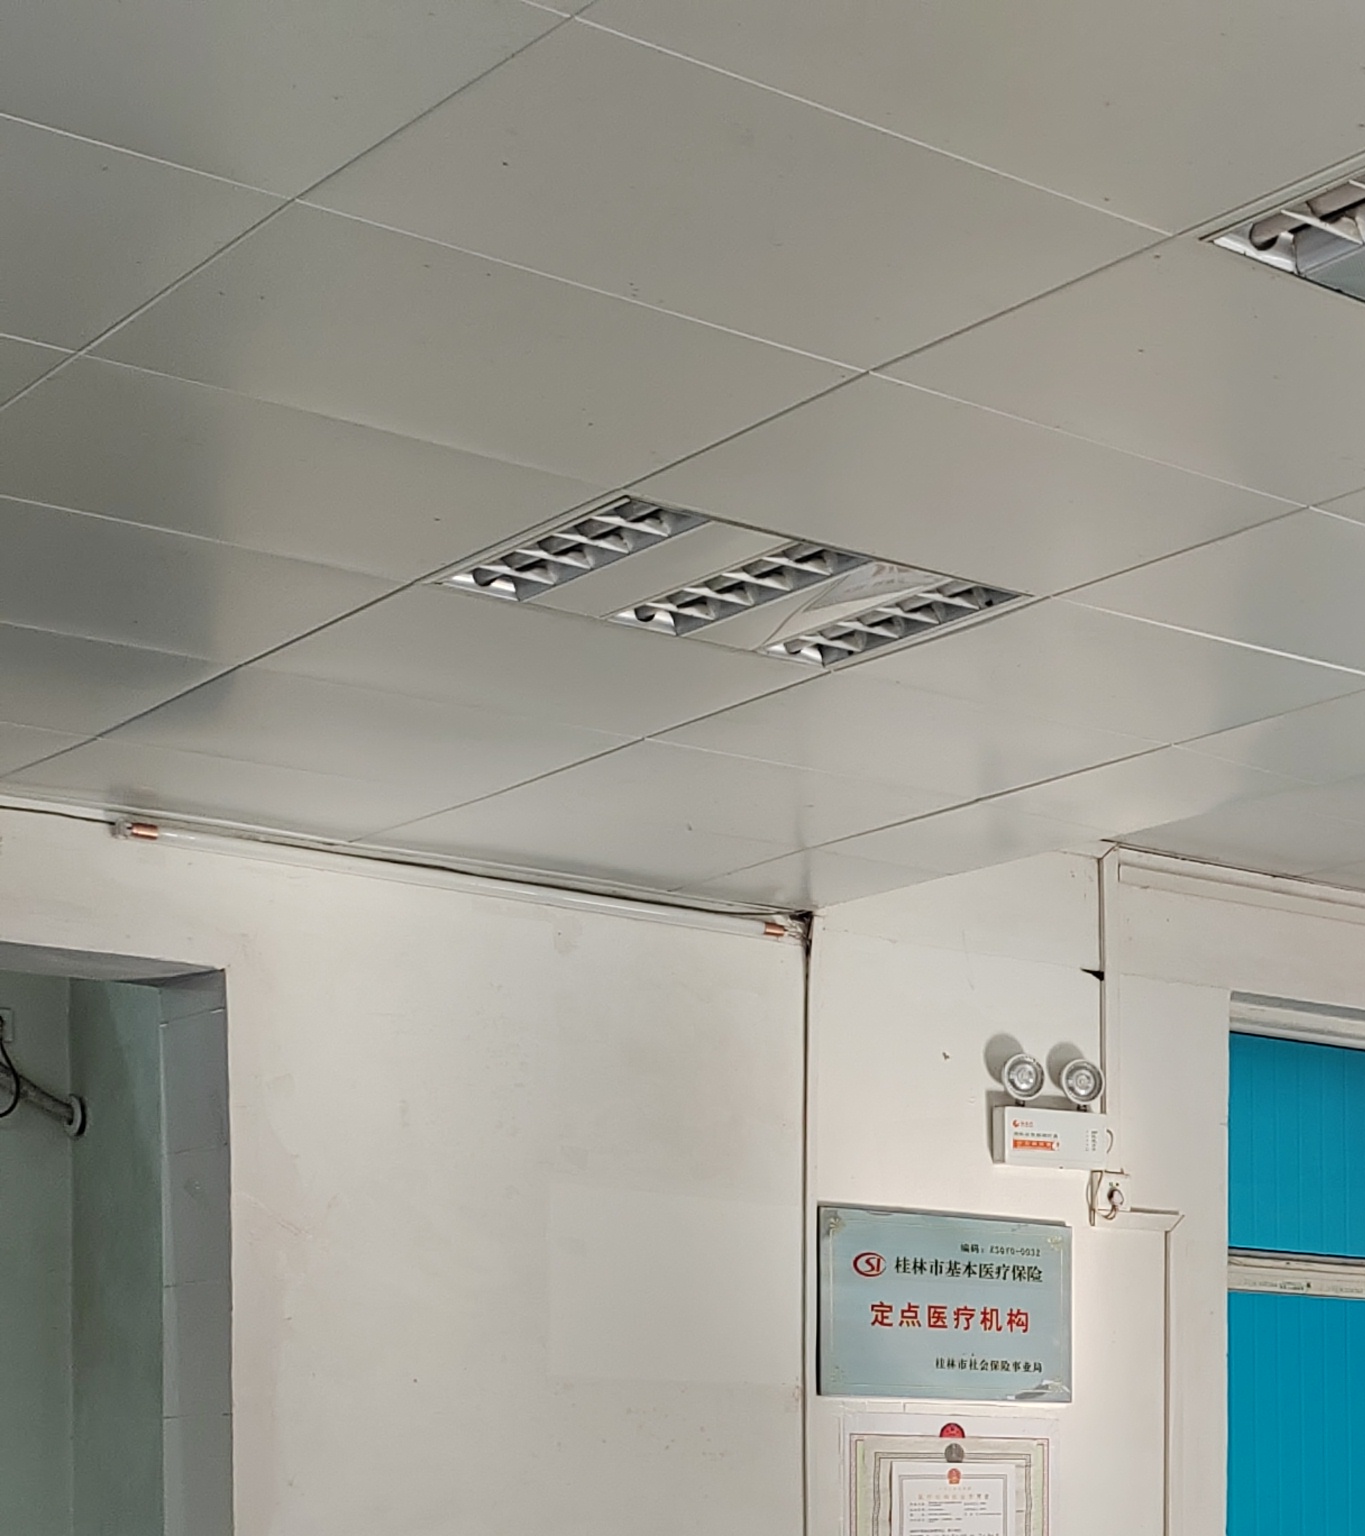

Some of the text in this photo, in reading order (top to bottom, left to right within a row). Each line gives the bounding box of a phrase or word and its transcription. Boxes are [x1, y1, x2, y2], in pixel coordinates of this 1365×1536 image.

[895, 1257, 1043, 1282] 桂林市基本医疗保险
[870, 1301, 1030, 1333] 定点医疗机构
[935, 1357, 1043, 1373] 桂林市社会保险事业局
